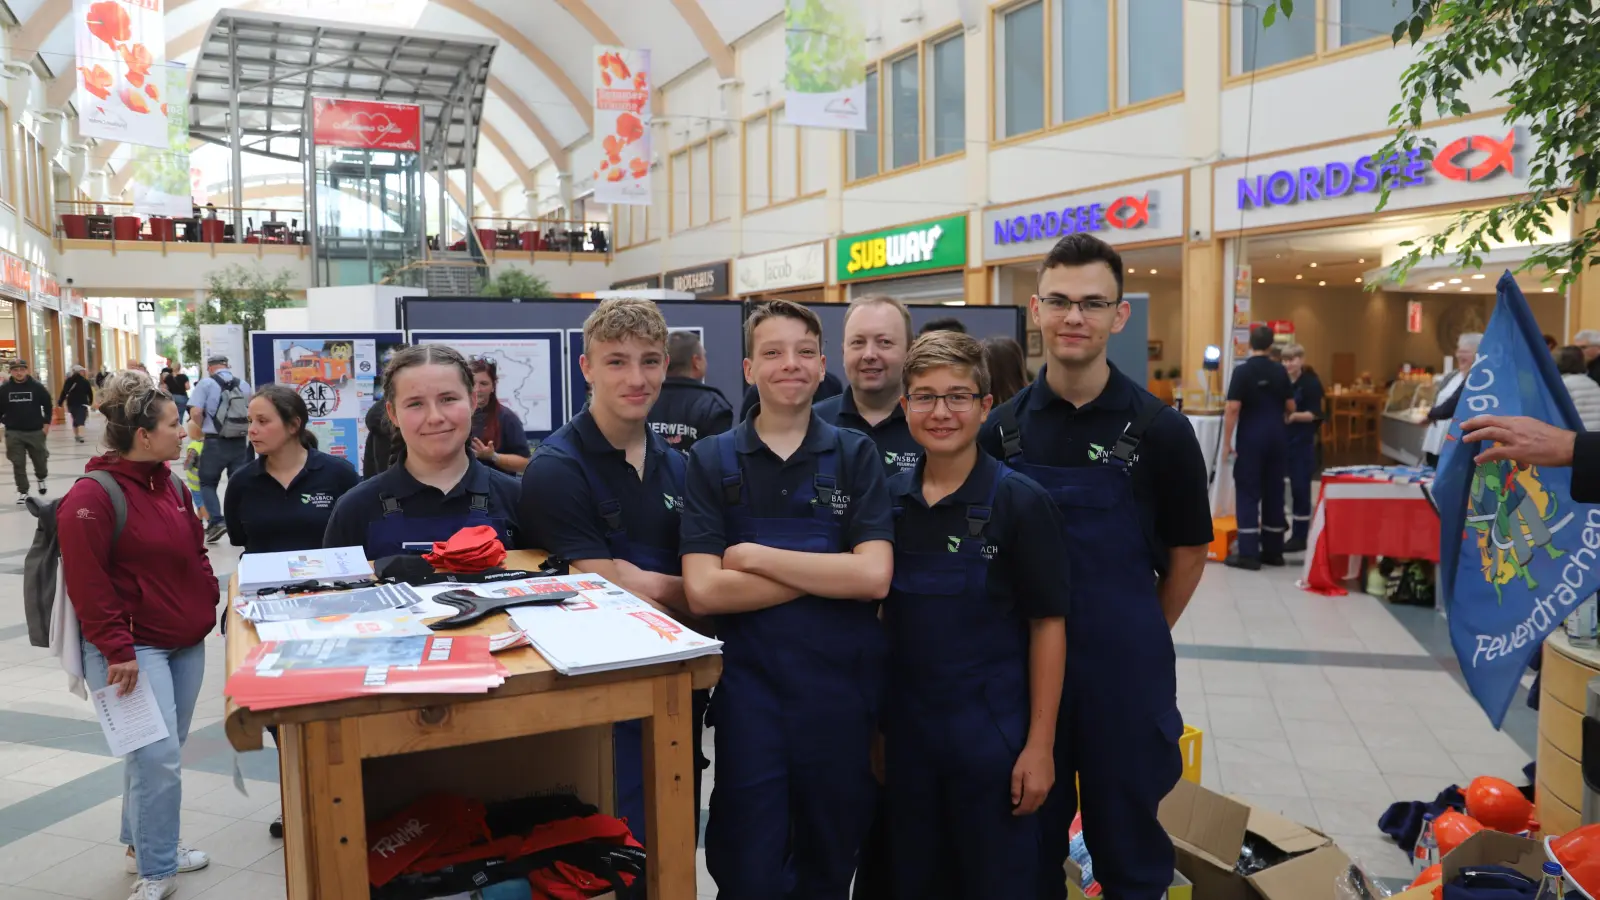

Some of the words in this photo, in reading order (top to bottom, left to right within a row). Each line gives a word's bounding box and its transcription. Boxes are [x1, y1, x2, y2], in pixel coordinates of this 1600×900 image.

[1237, 147, 1425, 210] NORDSEE
[846, 224, 943, 274] SUBWAY
[994, 203, 1101, 245] NORDSEE
[764, 255, 792, 285] Jacob
[1472, 508, 1600, 669] Feuerdrachen
